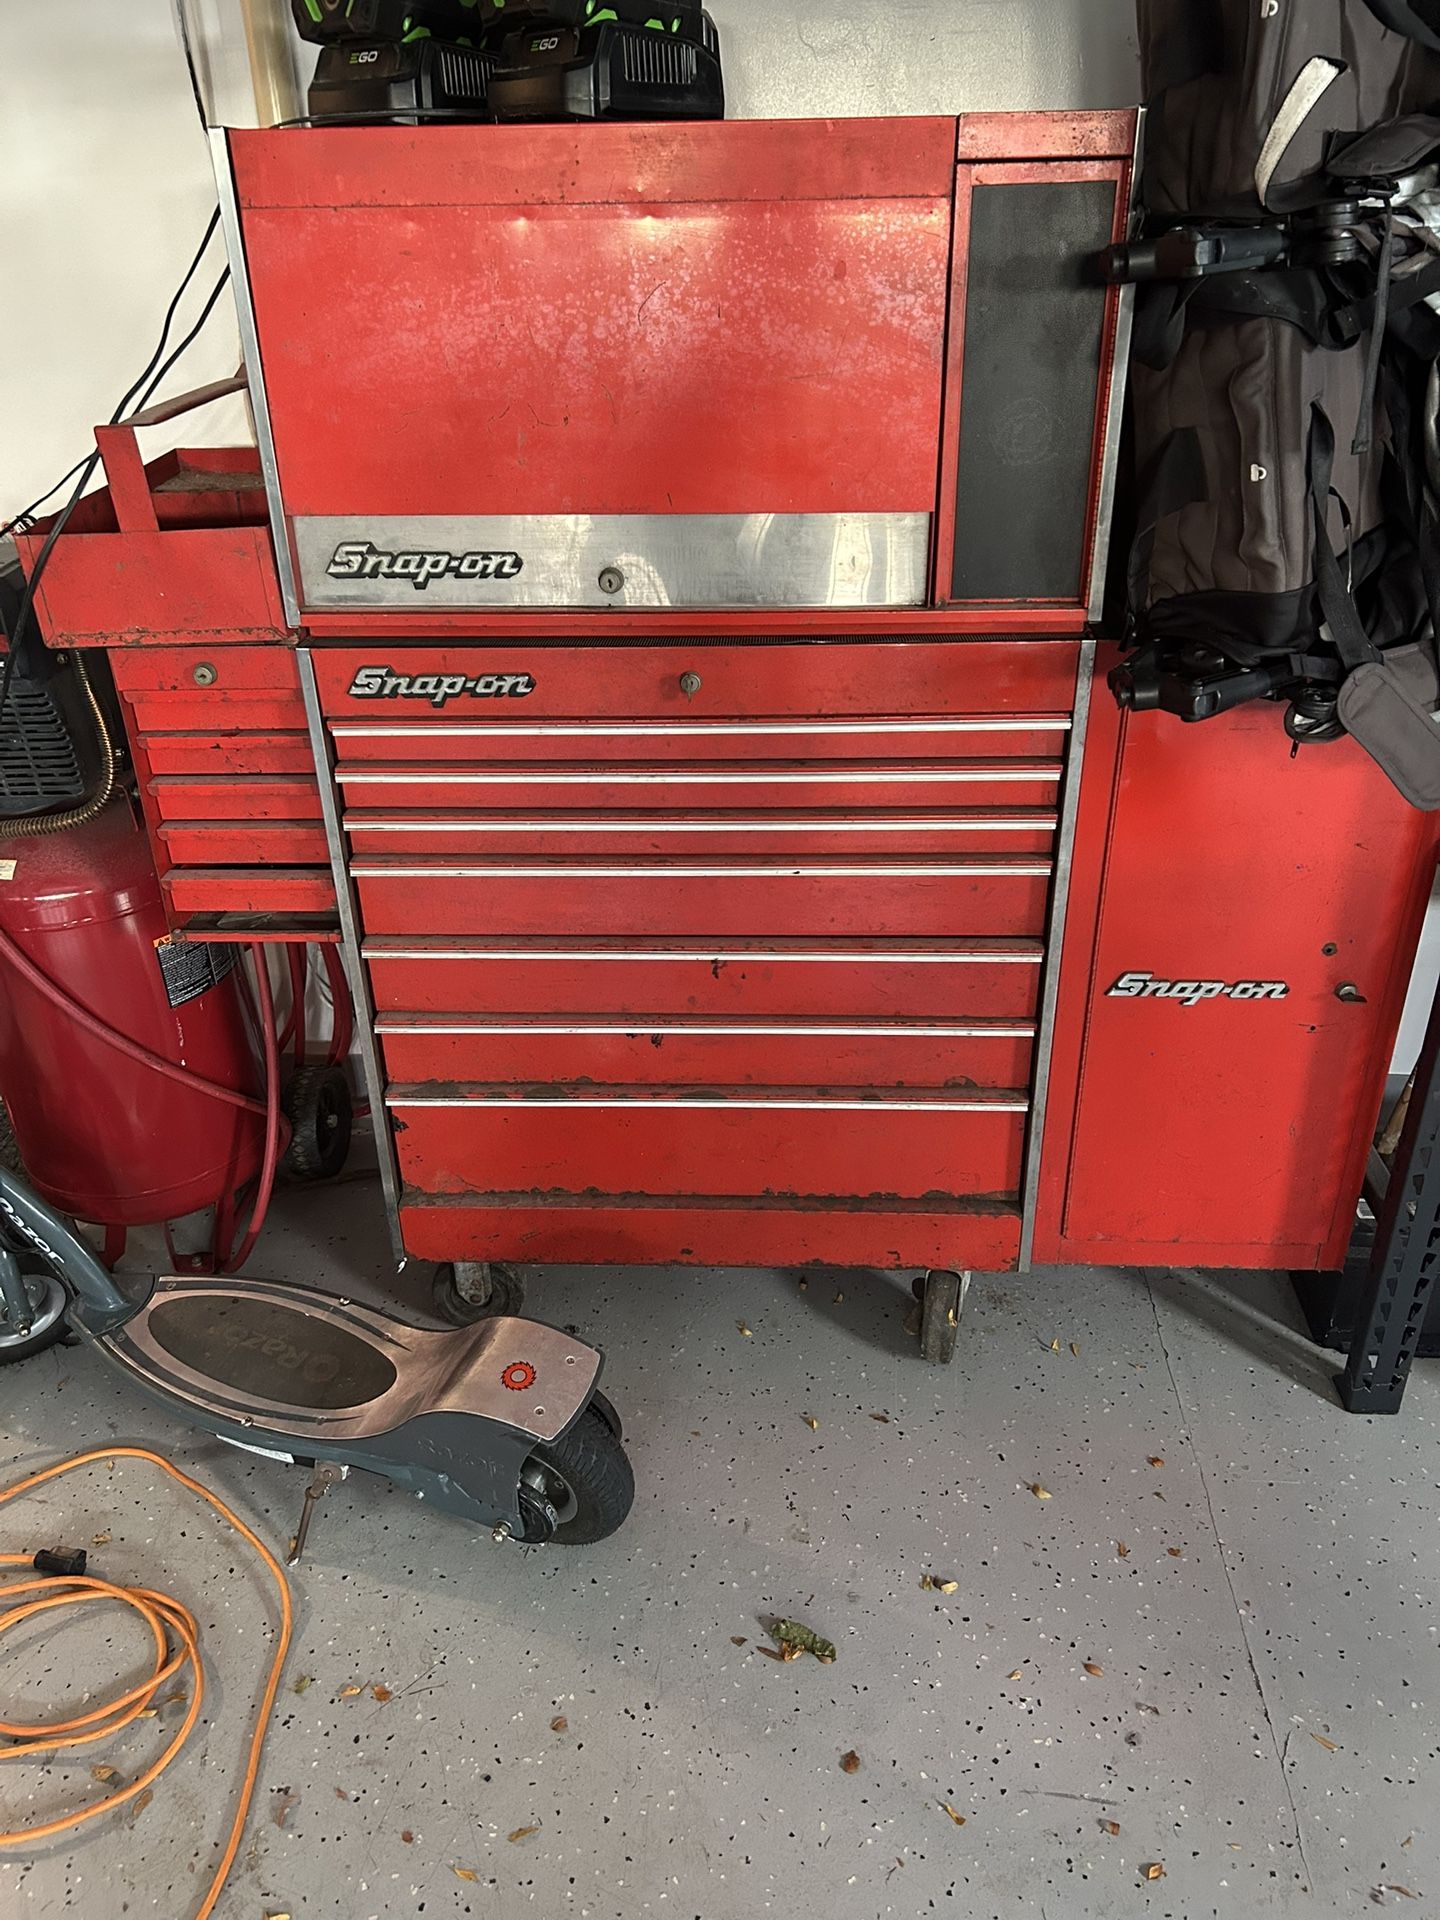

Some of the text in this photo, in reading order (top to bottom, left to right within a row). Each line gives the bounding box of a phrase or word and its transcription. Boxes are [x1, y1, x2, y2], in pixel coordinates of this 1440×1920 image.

[349, 50, 378, 64] EGO
[531, 37, 558, 51] EGO
[327, 541, 523, 590] Snap-on
[348, 665, 536, 708] Snap-on
[1104, 971, 1290, 1006] Snap-on
[218, 1322, 312, 1370] Razo
